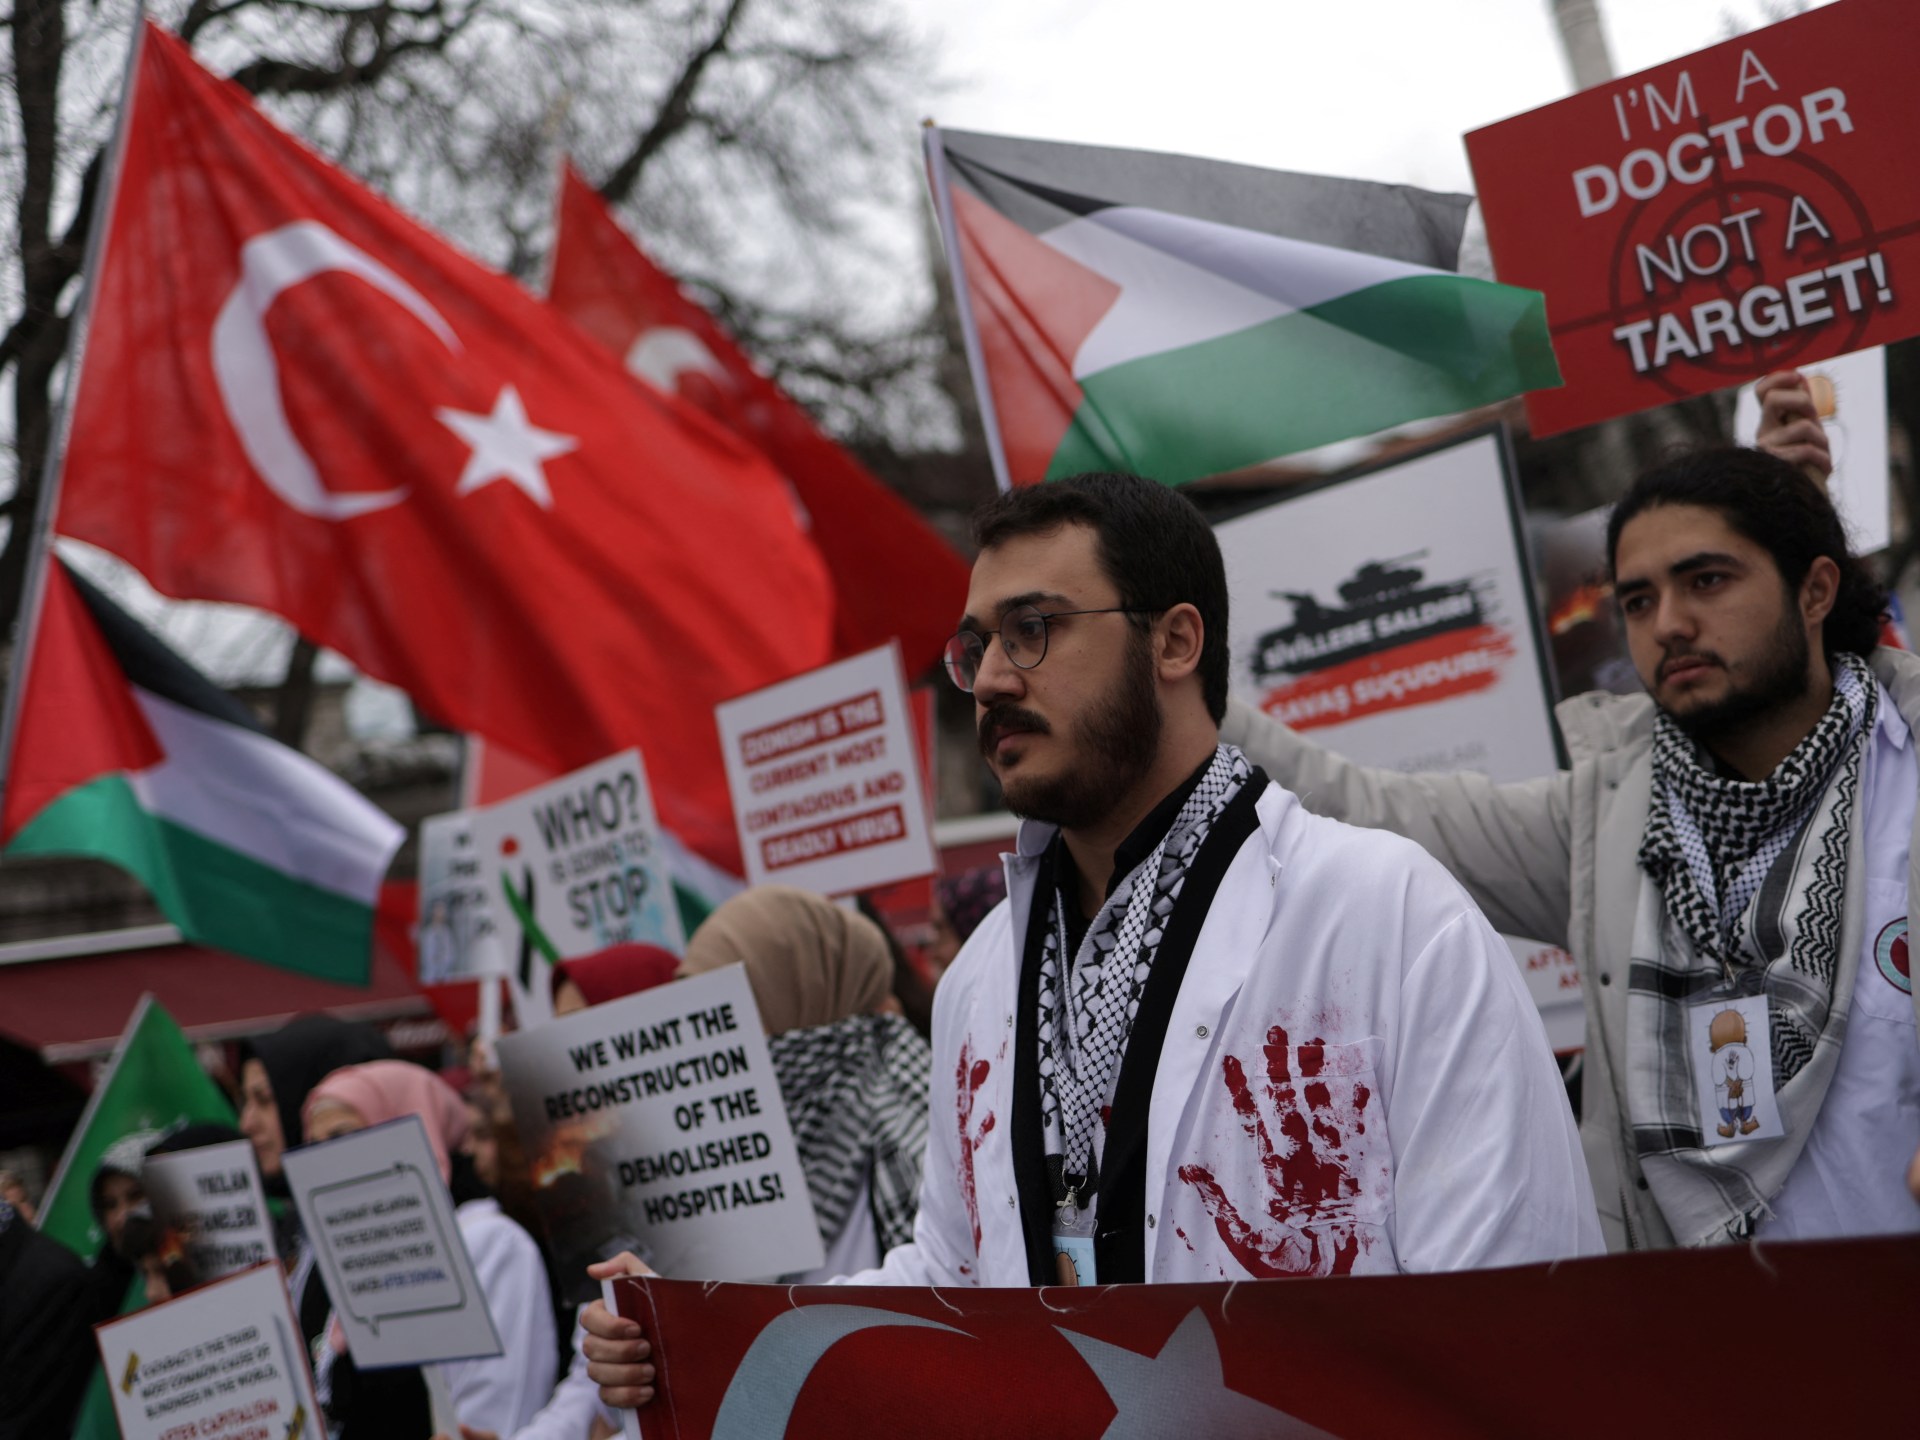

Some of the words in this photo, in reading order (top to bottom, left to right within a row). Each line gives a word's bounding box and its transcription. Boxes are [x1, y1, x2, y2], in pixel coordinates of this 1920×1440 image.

[1612, 70, 1700, 141] I'M
[1735, 49, 1779, 103] A
[1572, 87, 1854, 218] DOCTOR
[1636, 208, 1761, 292] NOT
[1785, 195, 1829, 250] A
[1613, 252, 1892, 372] TARGET!
[534, 771, 638, 849] WHO?
[568, 866, 648, 929] STOP
[569, 1041, 610, 1073] WE
[611, 1019, 682, 1061] WANT
[687, 1003, 738, 1040] THE
[544, 1045, 750, 1121] RECONSTRUCTION
[673, 1101, 707, 1132] OF
[711, 1088, 762, 1123] THE
[618, 1131, 771, 1188] DEMOLISHED
[643, 1173, 785, 1225] HOSPITALS!
